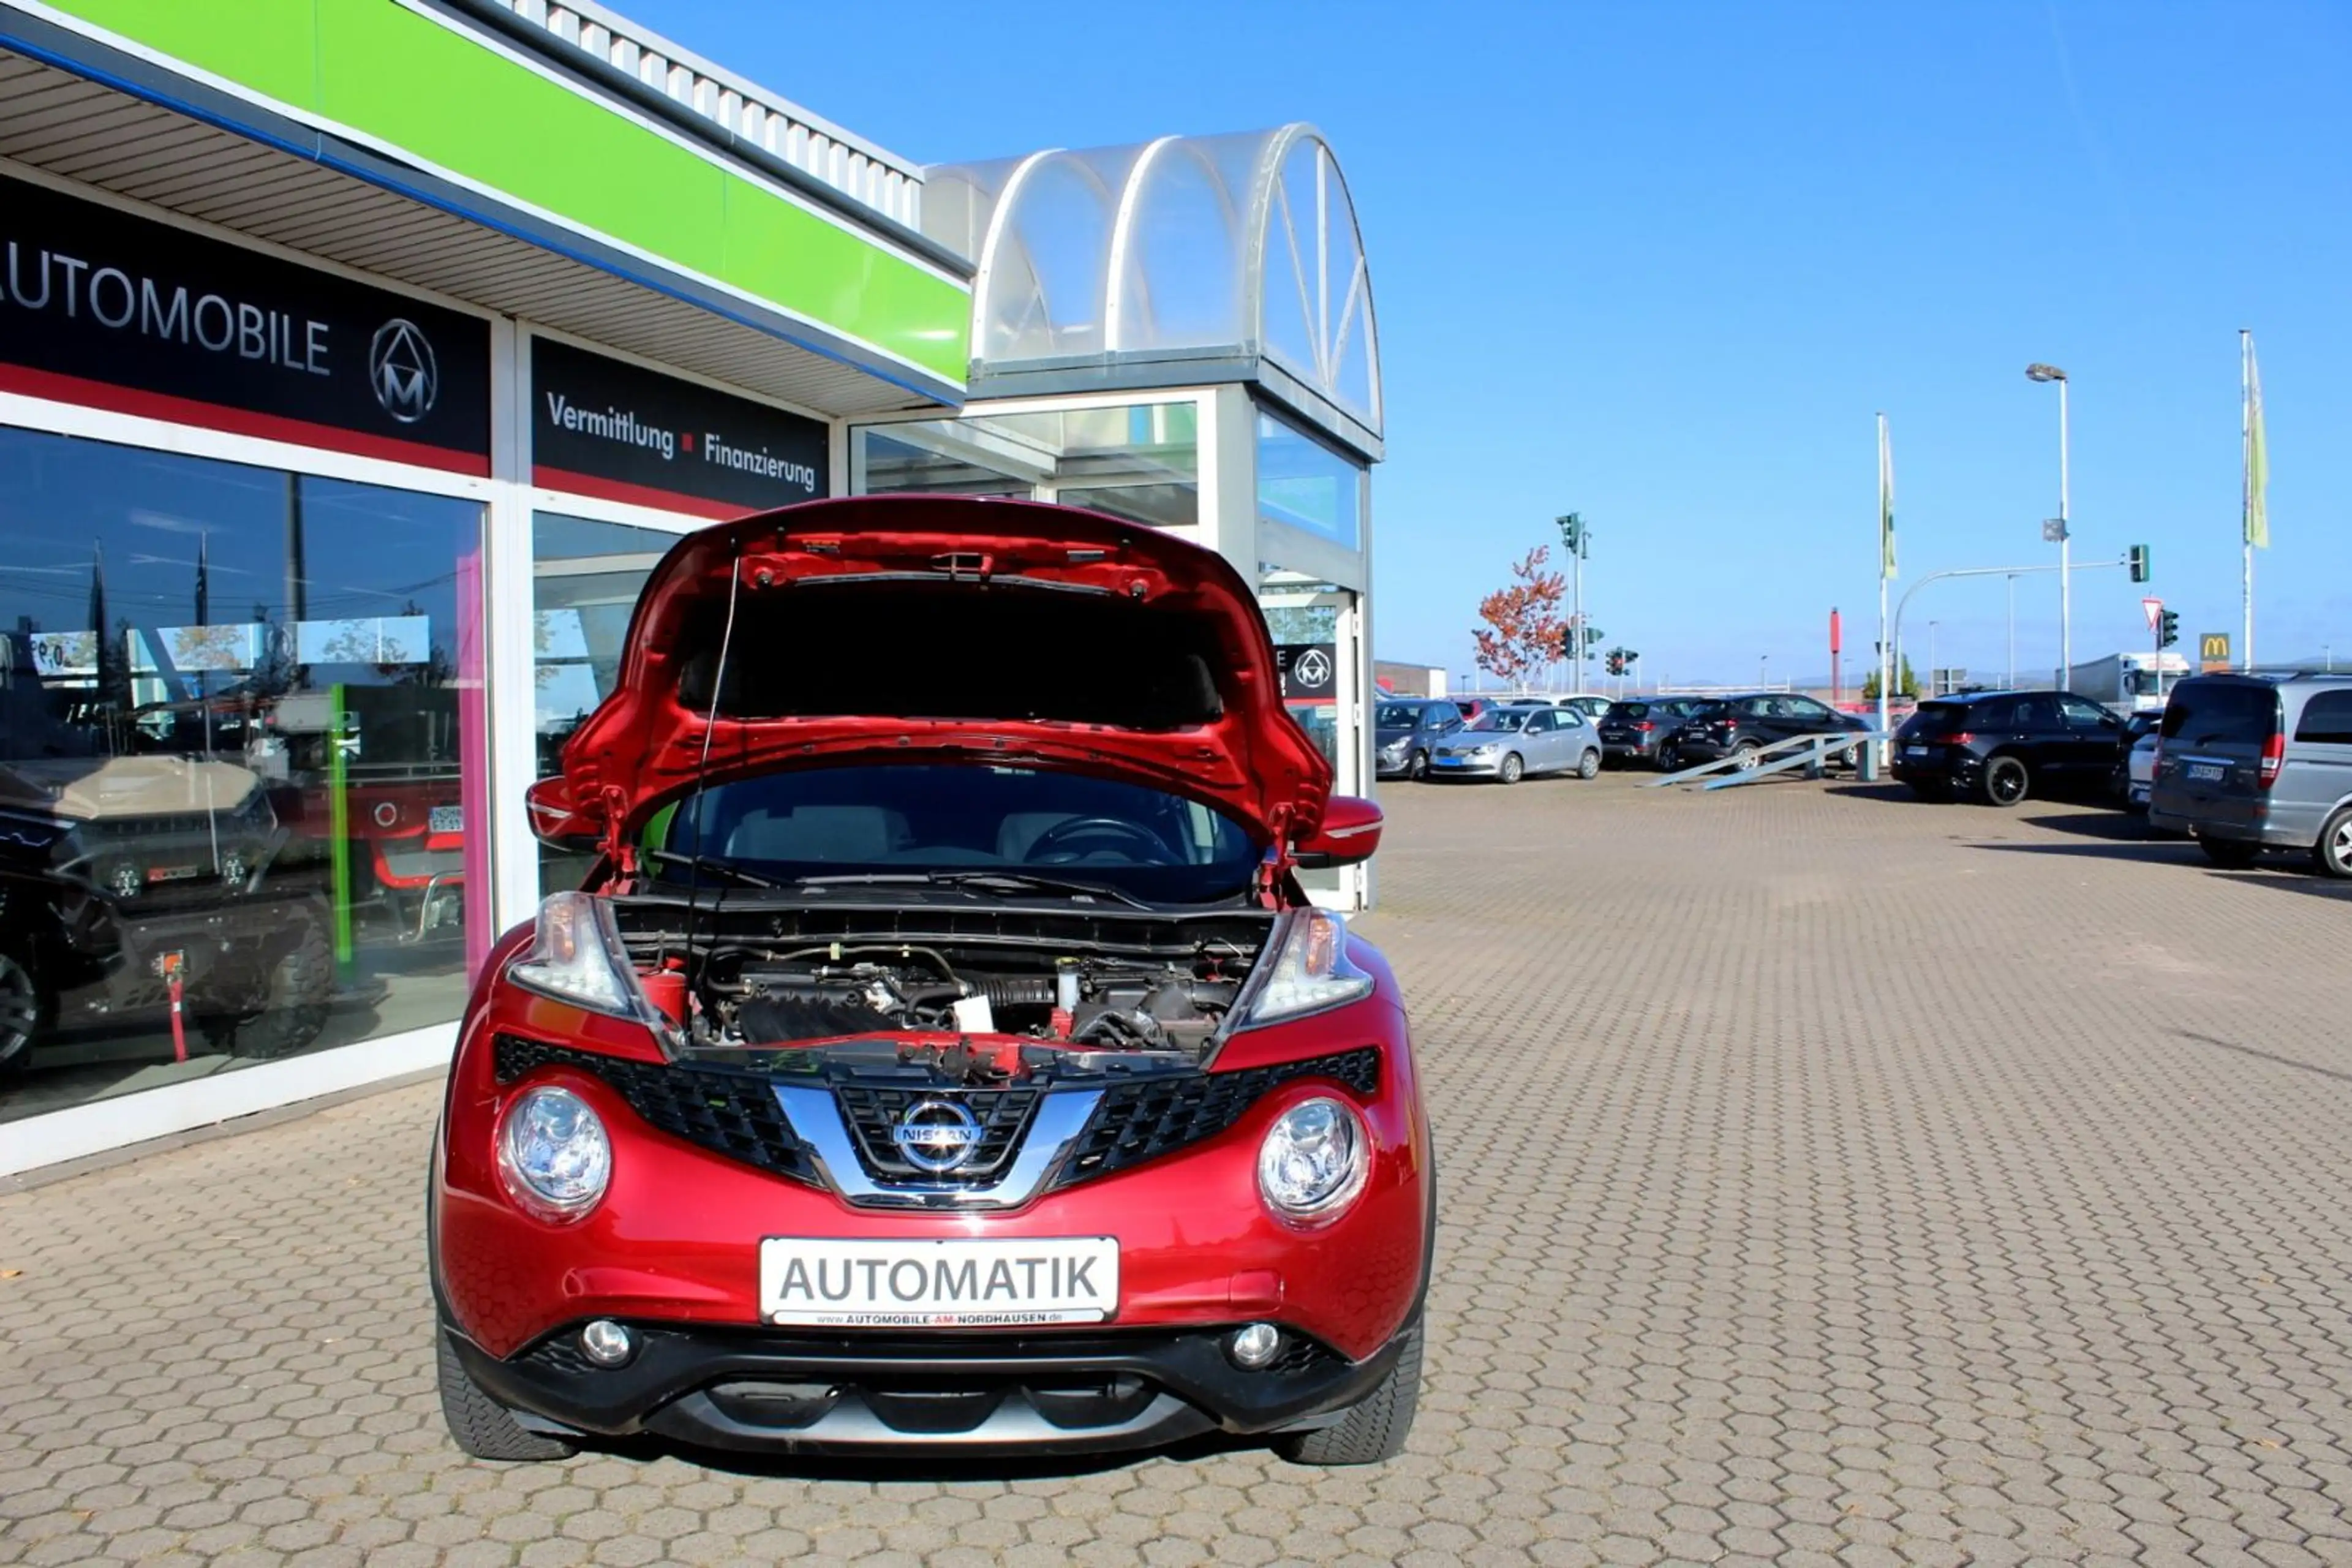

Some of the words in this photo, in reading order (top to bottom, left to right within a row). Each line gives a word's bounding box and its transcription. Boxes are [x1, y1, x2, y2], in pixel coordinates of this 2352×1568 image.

[0, 241, 330, 375] UTOMOBILE
[546, 391, 674, 461] Vermittlung
[705, 432, 815, 493] Finanzierung
[779, 1256, 1098, 1302] AUTOMATIK
